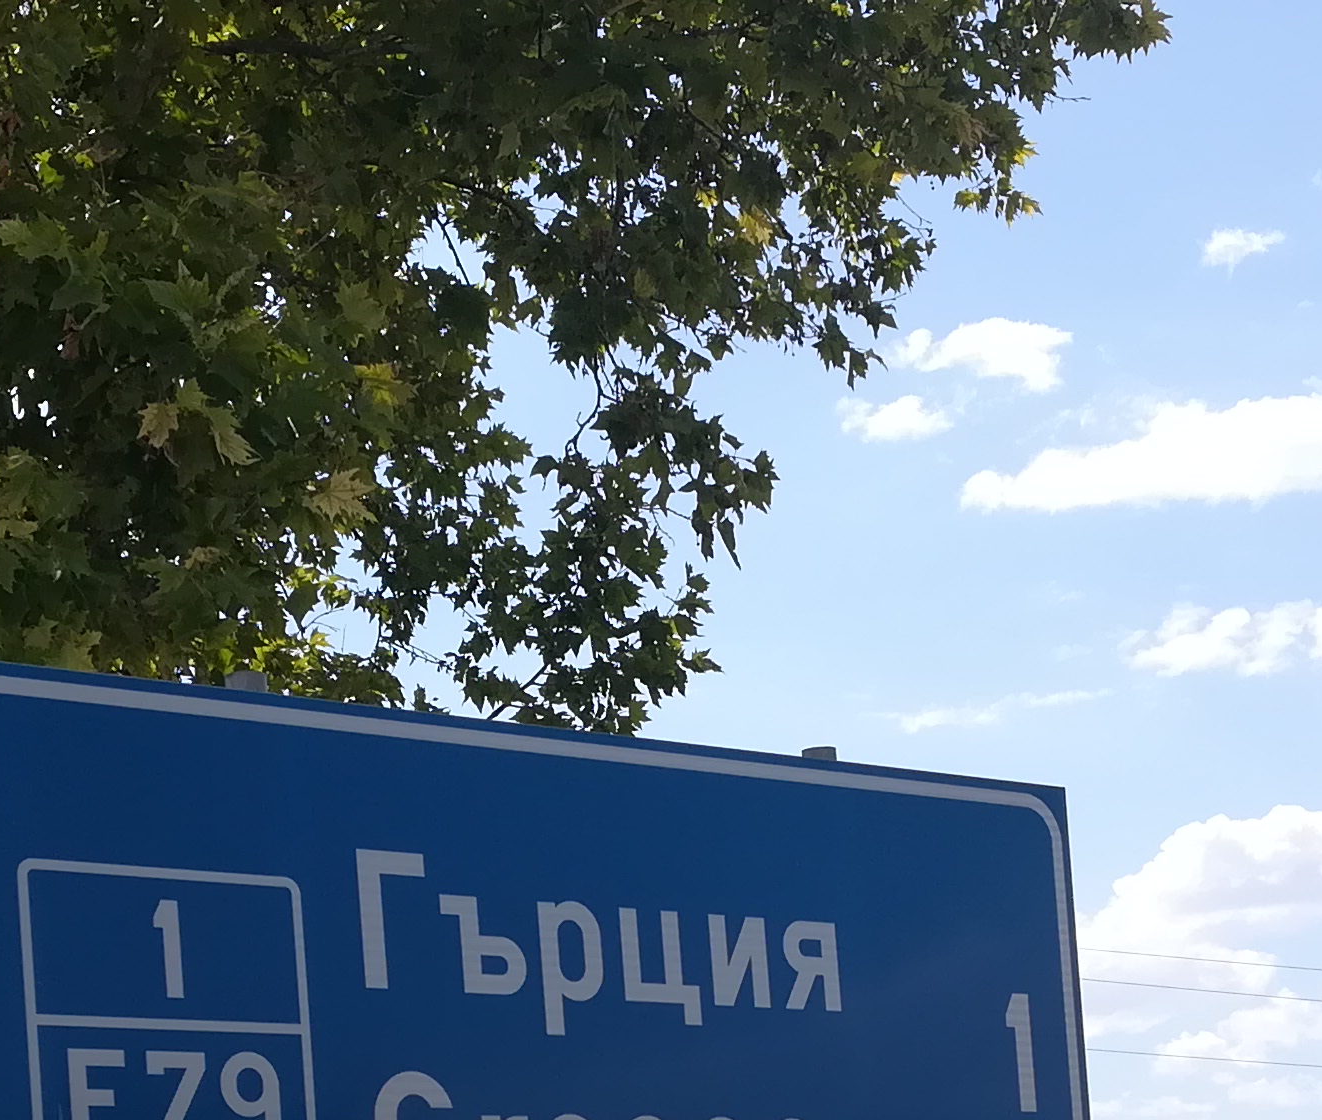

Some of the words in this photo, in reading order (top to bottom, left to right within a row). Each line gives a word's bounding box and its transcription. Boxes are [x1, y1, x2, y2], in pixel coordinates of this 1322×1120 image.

[152, 898, 186, 1000] 1
[354, 847, 844, 1037] Гърция
[1004, 991, 1038, 1114] 1
